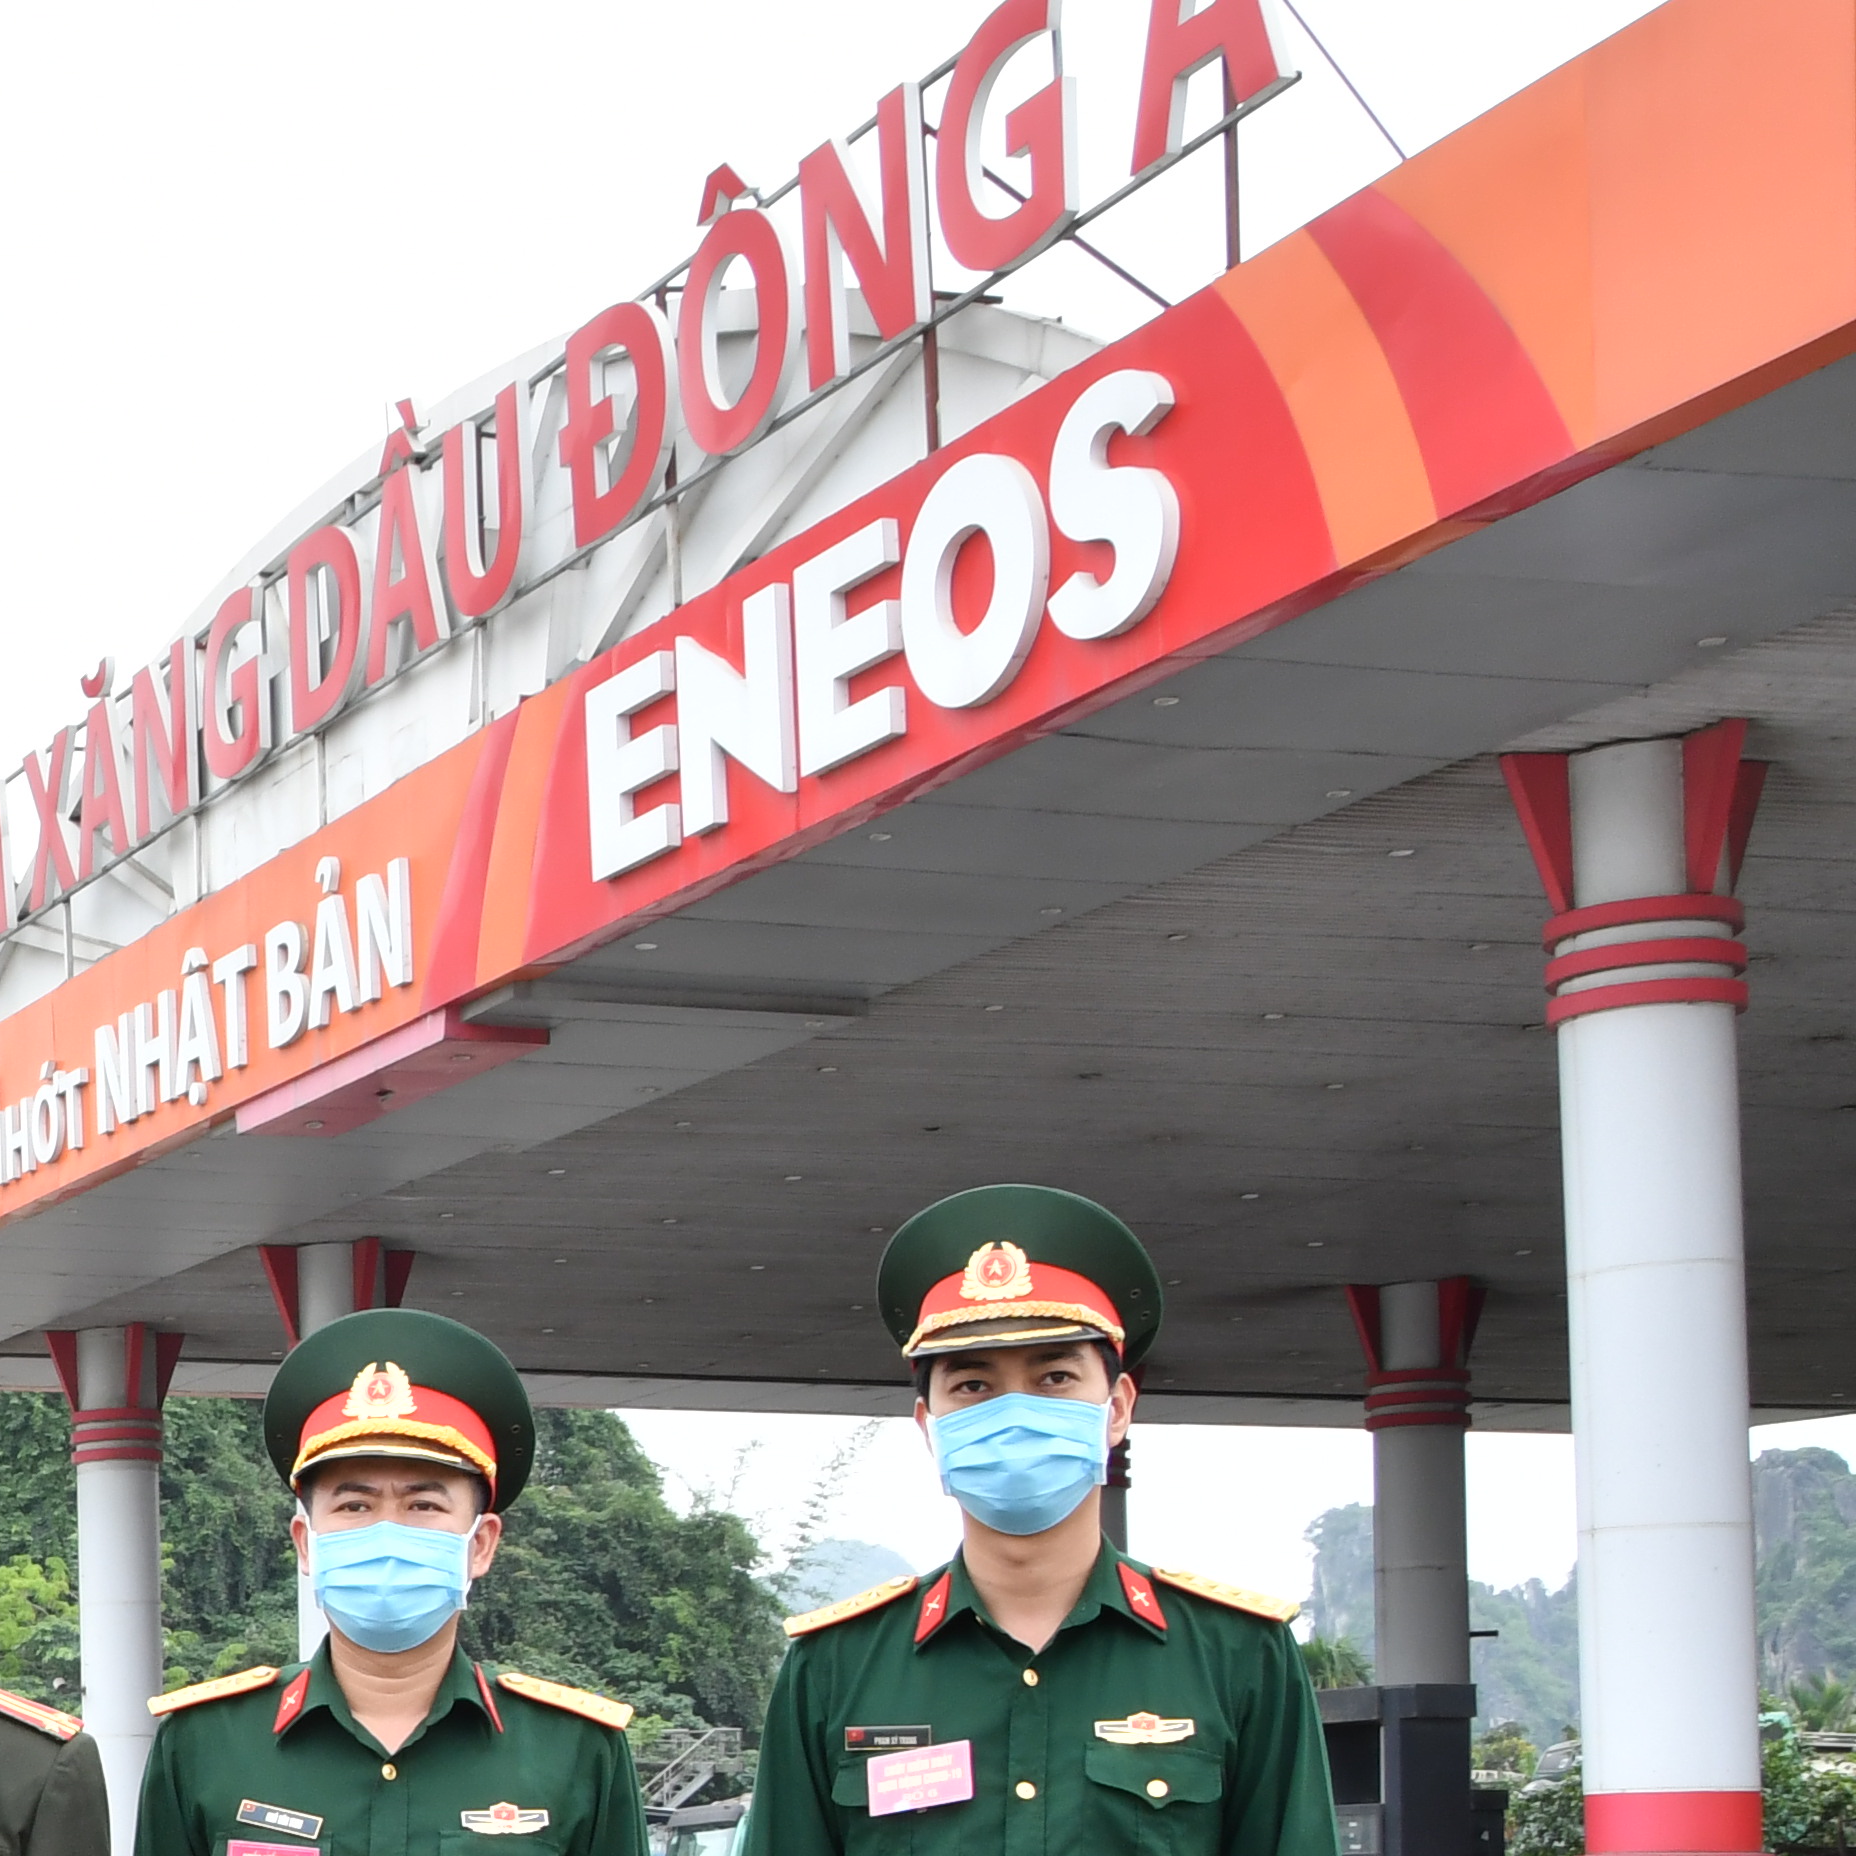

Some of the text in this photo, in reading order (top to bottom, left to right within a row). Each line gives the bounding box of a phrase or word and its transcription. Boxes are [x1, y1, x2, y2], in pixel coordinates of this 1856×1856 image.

[23, 585, 273, 913] XĂNG
[289, 380, 531, 736] DẦU
[560, 0, 1078, 549] ĐÔNG
[586, 367, 1180, 883] ENEOS
[94, 944, 258, 1135] NHẬT
[263, 856, 414, 1050] BẢN
